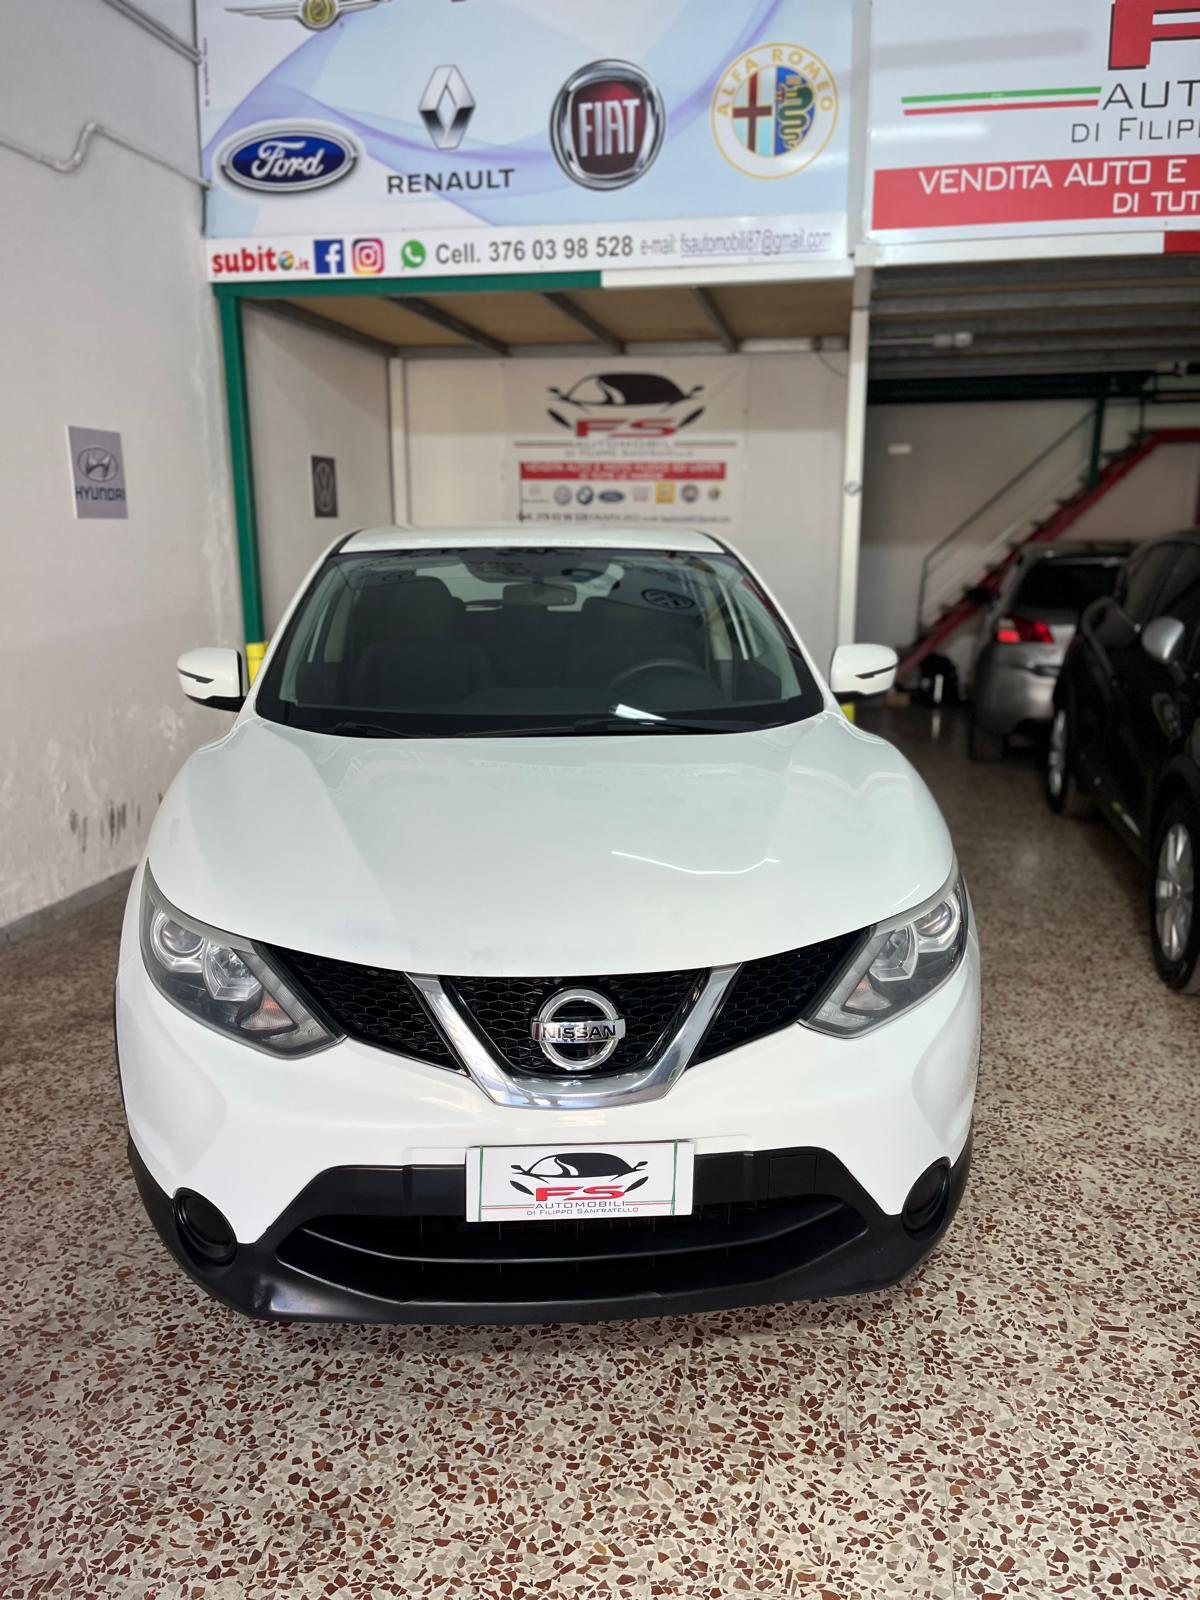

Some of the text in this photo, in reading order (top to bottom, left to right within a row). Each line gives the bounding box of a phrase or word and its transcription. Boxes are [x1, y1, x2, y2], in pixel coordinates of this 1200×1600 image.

[718, 48, 834, 117] ALFA ROMEO
[578, 98, 641, 157] FIAT
[1071, 117, 1200, 143] DI FILIP
[251, 140, 324, 178] Ford
[387, 169, 515, 194] RENAULT
[918, 159, 1187, 195] VENDITA AUTO E
[1112, 192, 1139, 214] DI
[435, 242, 481, 265] Cell.
[489, 240, 525, 262] 376
[532, 239, 557, 260] 03
[563, 237, 588, 259] 98
[596, 235, 633, 257] 528
[576, 418, 677, 437] FS
[543, 1024, 616, 1039] NISSAN
[535, 1185, 625, 1203] FS
[535, 1200, 625, 1210] AUTOMOBILI
[539, 1208, 573, 1216] FILIPPO
[576, 1207, 639, 1215] SANFRATELLO
